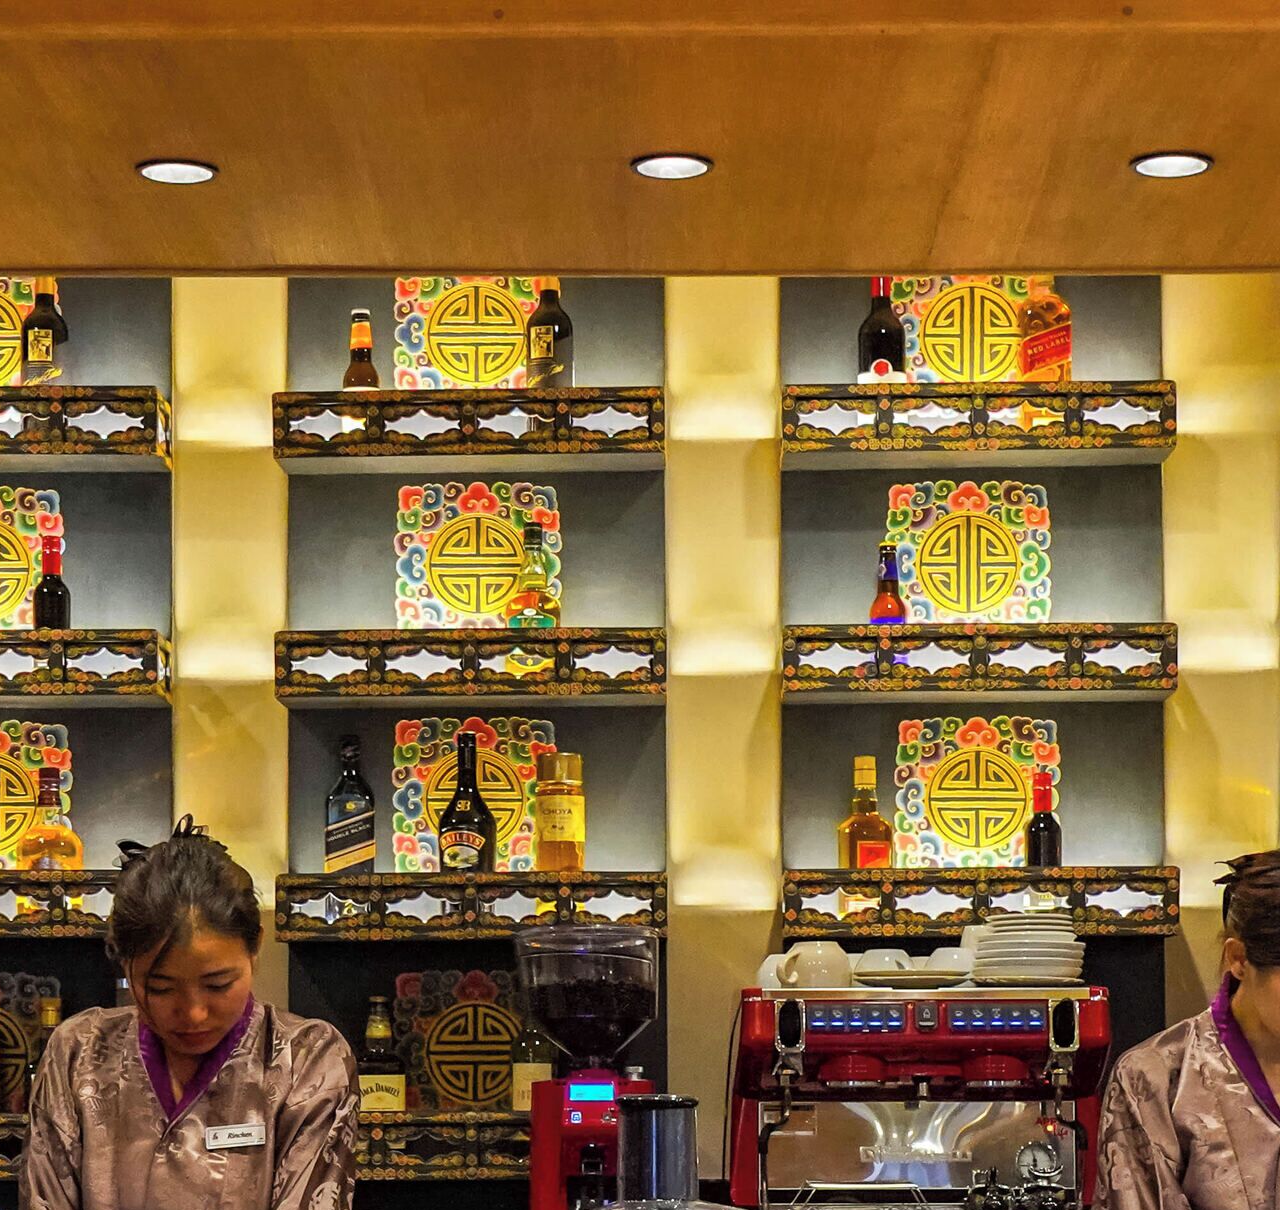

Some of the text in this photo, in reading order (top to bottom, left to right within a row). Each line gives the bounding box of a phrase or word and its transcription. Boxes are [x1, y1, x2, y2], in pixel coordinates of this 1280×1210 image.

[1027, 345, 1044, 355] RED
[1045, 336, 1071, 349] LABEL
[440, 832, 481, 848] BAILEYS
